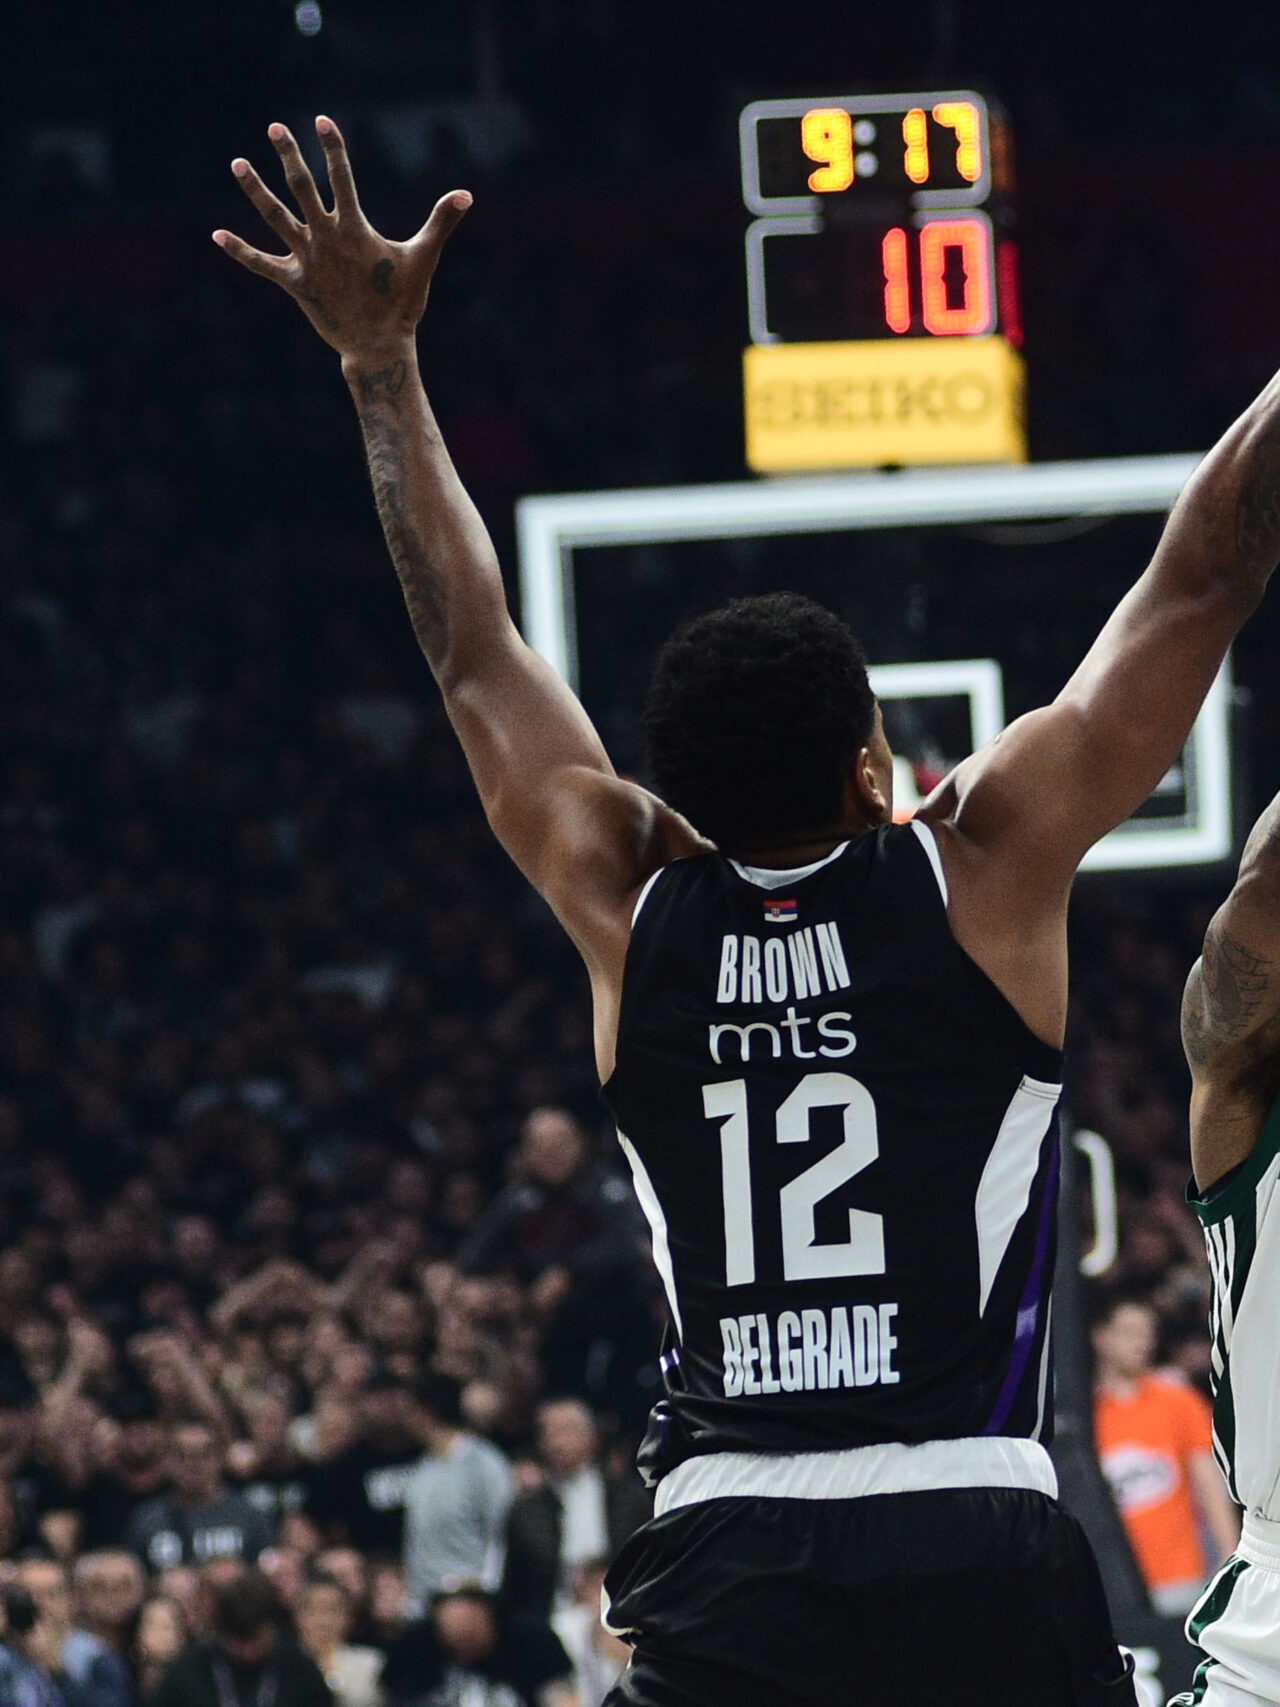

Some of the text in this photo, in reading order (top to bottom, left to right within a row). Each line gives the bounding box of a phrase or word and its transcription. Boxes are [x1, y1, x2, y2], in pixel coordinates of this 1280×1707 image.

[883, 220, 992, 336] 10
[757, 370, 992, 432] SEIKO
[716, 921, 852, 1004] BROWN
[708, 1006, 858, 1065] mts
[701, 1071, 886, 1287] 12
[719, 1302, 900, 1398] BELGRADE
